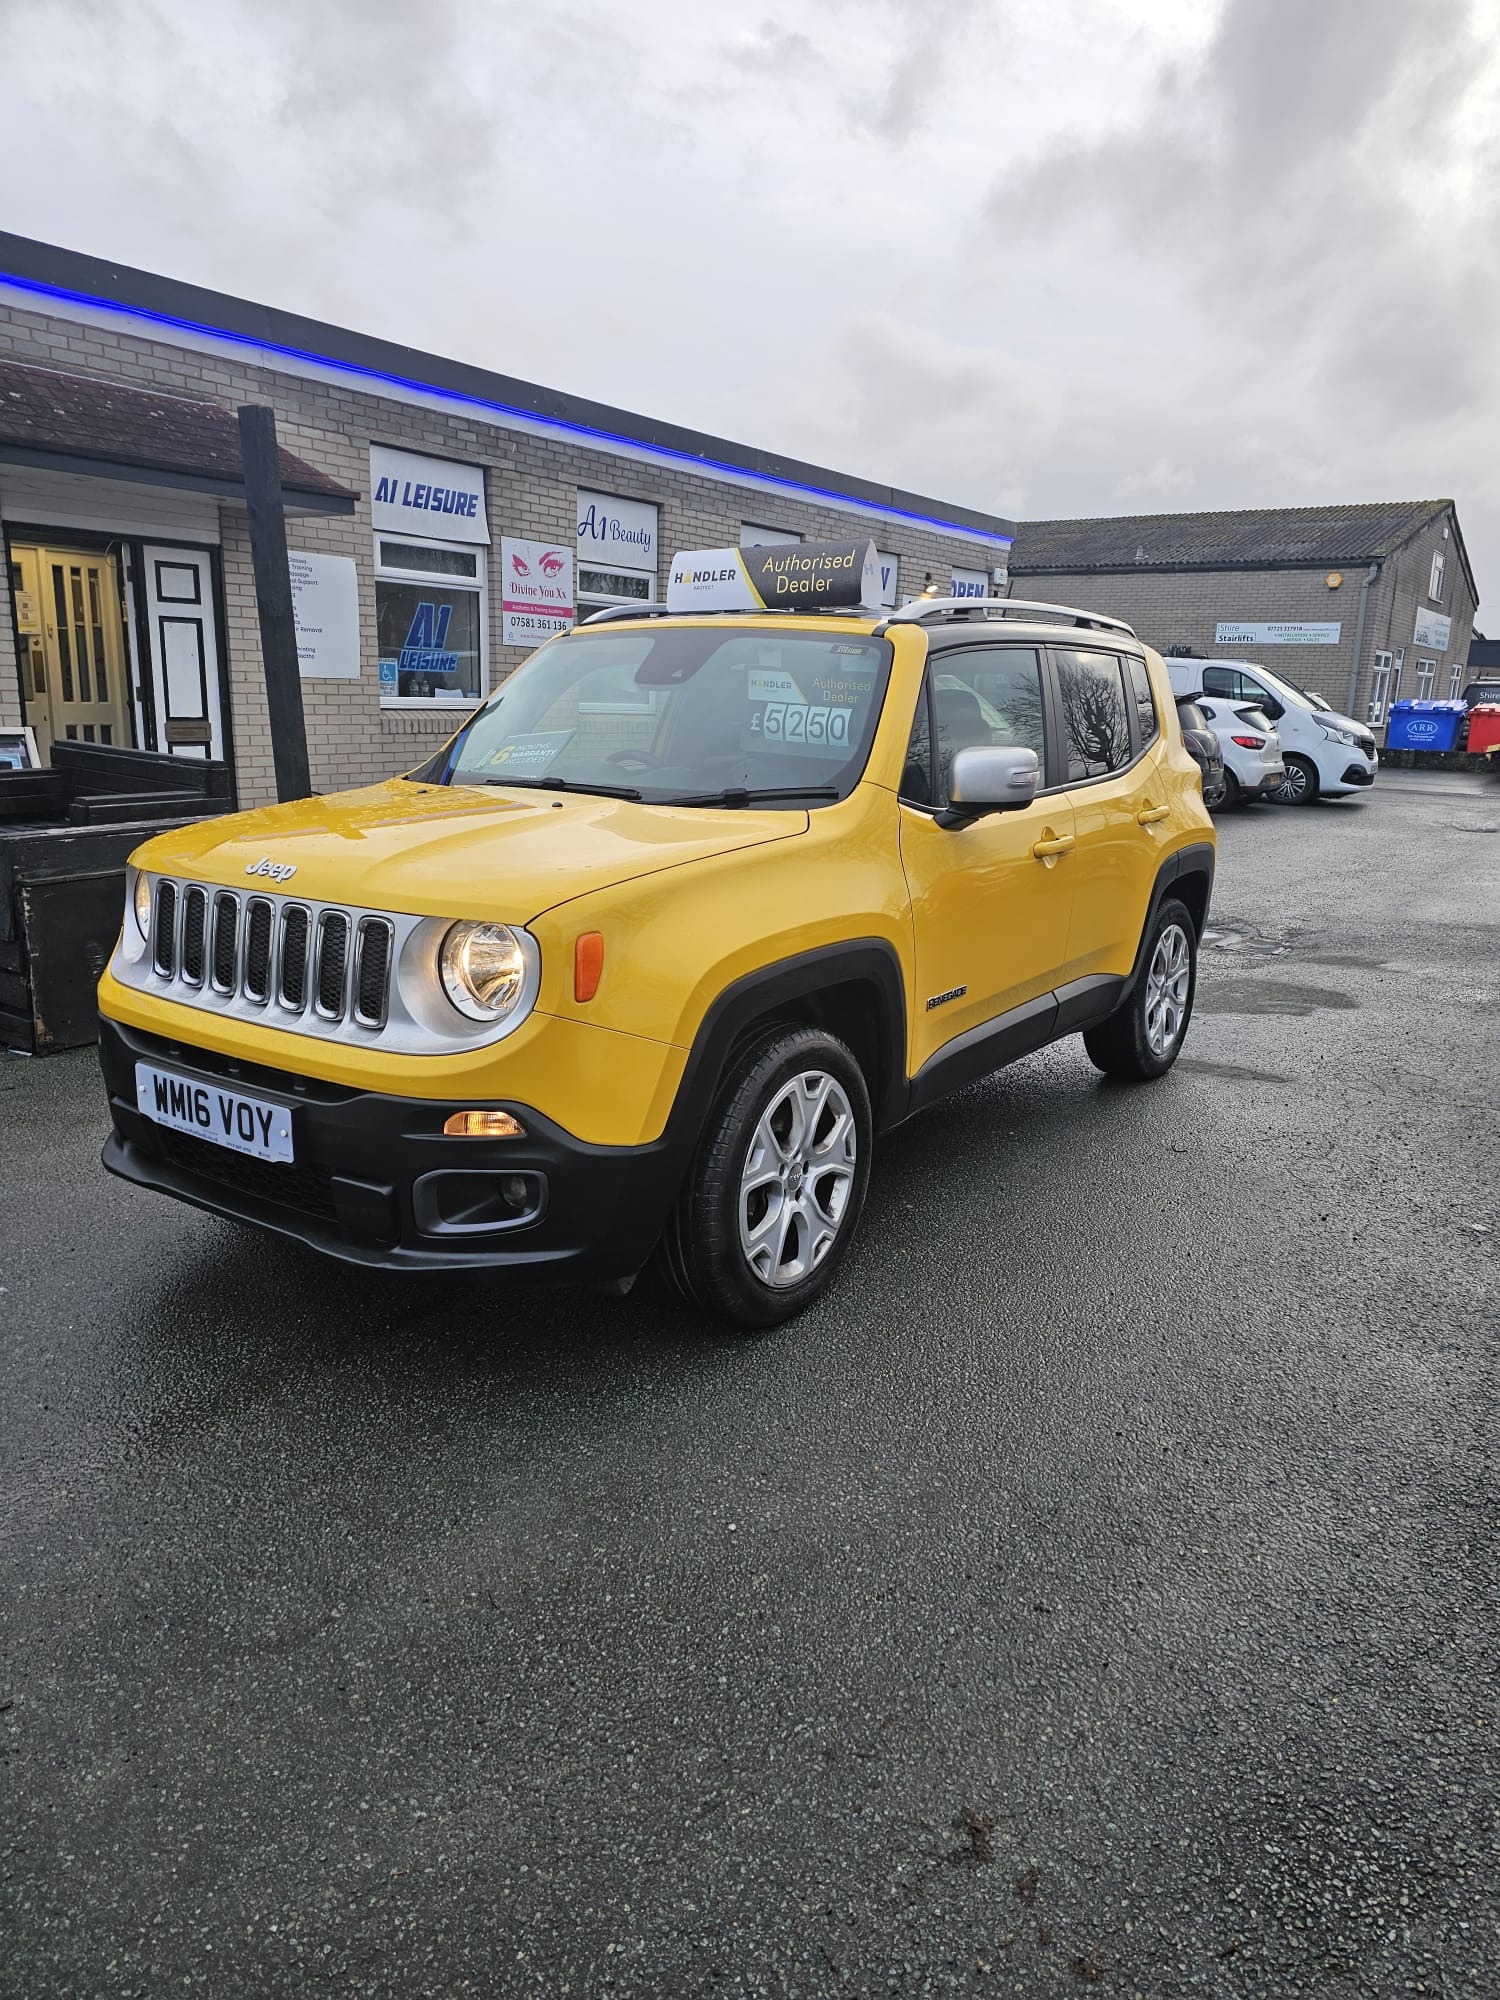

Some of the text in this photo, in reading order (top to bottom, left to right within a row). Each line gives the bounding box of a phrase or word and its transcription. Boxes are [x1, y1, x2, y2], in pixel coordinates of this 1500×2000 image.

[402, 481, 479, 517] LEISURE
[577, 504, 651, 553] A1 Beauty
[761, 549, 856, 574] Authorised
[509, 581, 567, 601] Divine You Xx
[776, 573, 833, 595] Dealer
[511, 616, 567, 631] 07581 361 136
[1219, 624, 1240, 632] Shire
[1218, 634, 1254, 642] Stairlifts
[398, 649, 460, 672] LEISURE
[813, 678, 872, 691] Authorised
[823, 690, 859, 703] Dealer
[750, 709, 846, 740] £5250
[1410, 723, 1434, 732] ARR
[490, 745, 516, 766] 6
[510, 749, 560, 758] WARRANTY
[517, 742, 552, 751] MONTHS
[245, 856, 298, 883] Jeep
[926, 984, 968, 1012] RENEGADE
[153, 1074, 274, 1148] WM16 VOY
